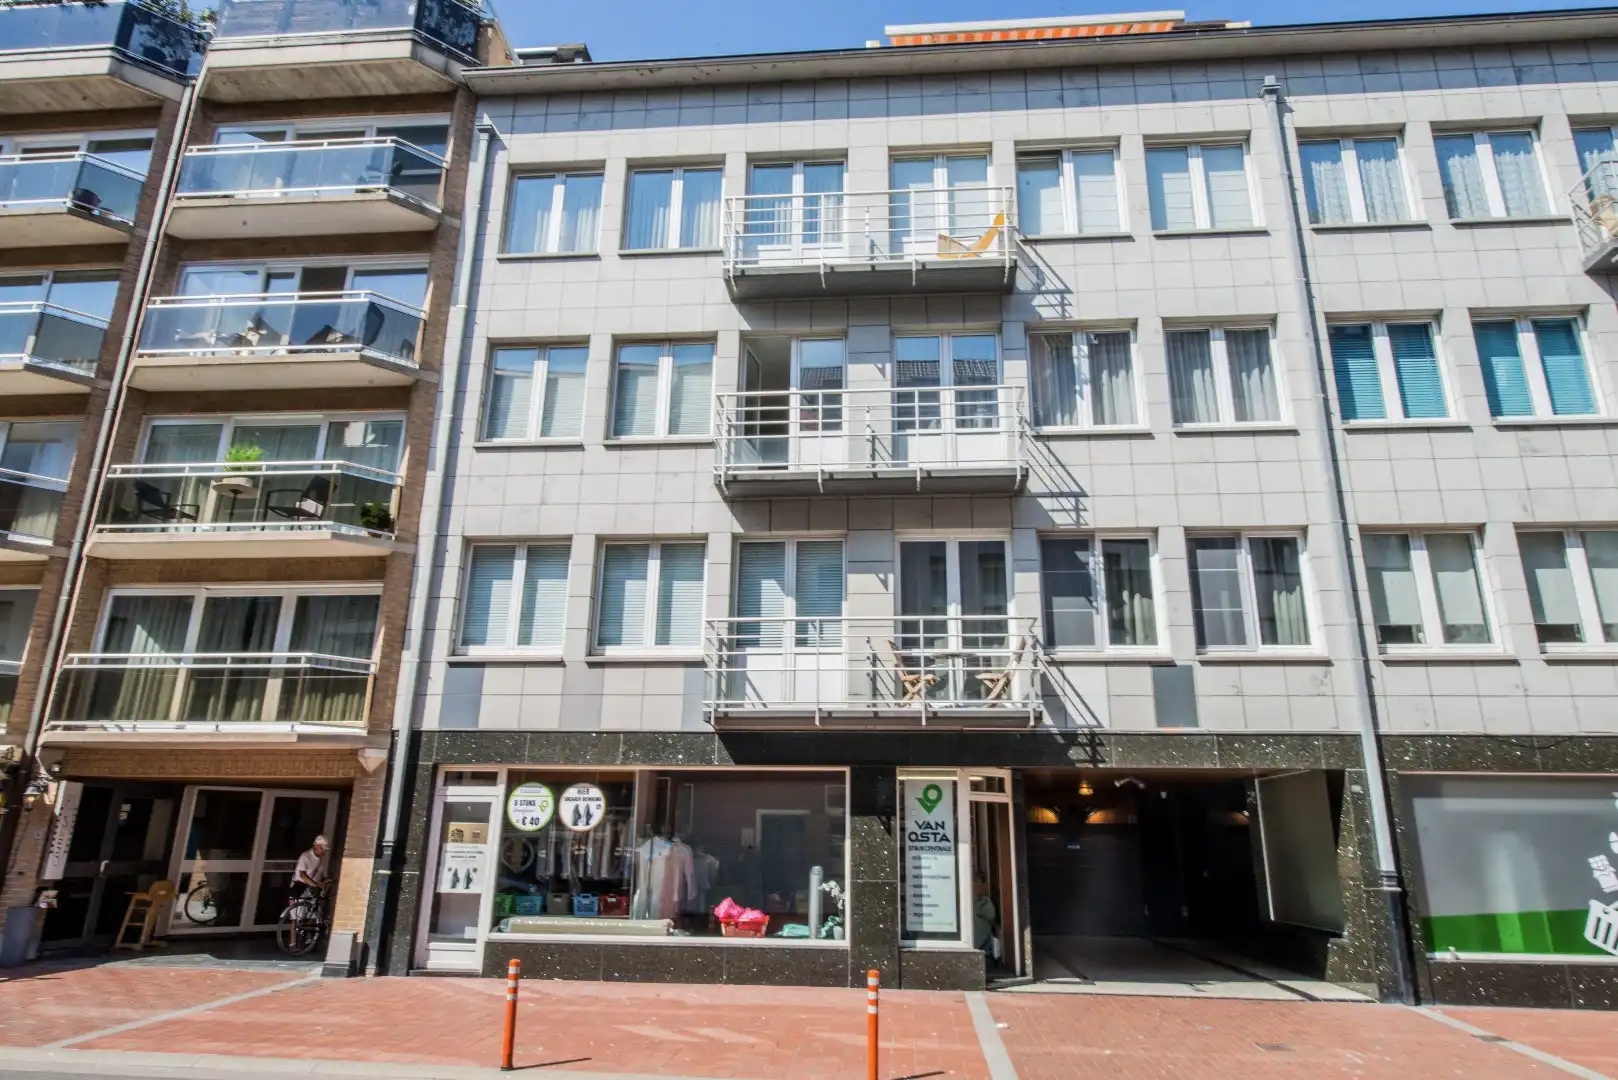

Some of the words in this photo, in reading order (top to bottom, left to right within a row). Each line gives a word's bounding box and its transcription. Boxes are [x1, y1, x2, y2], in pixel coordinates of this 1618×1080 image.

[529, 816, 540, 826] 40
[914, 820, 945, 831] VAN
[908, 831, 951, 843] OSTA
